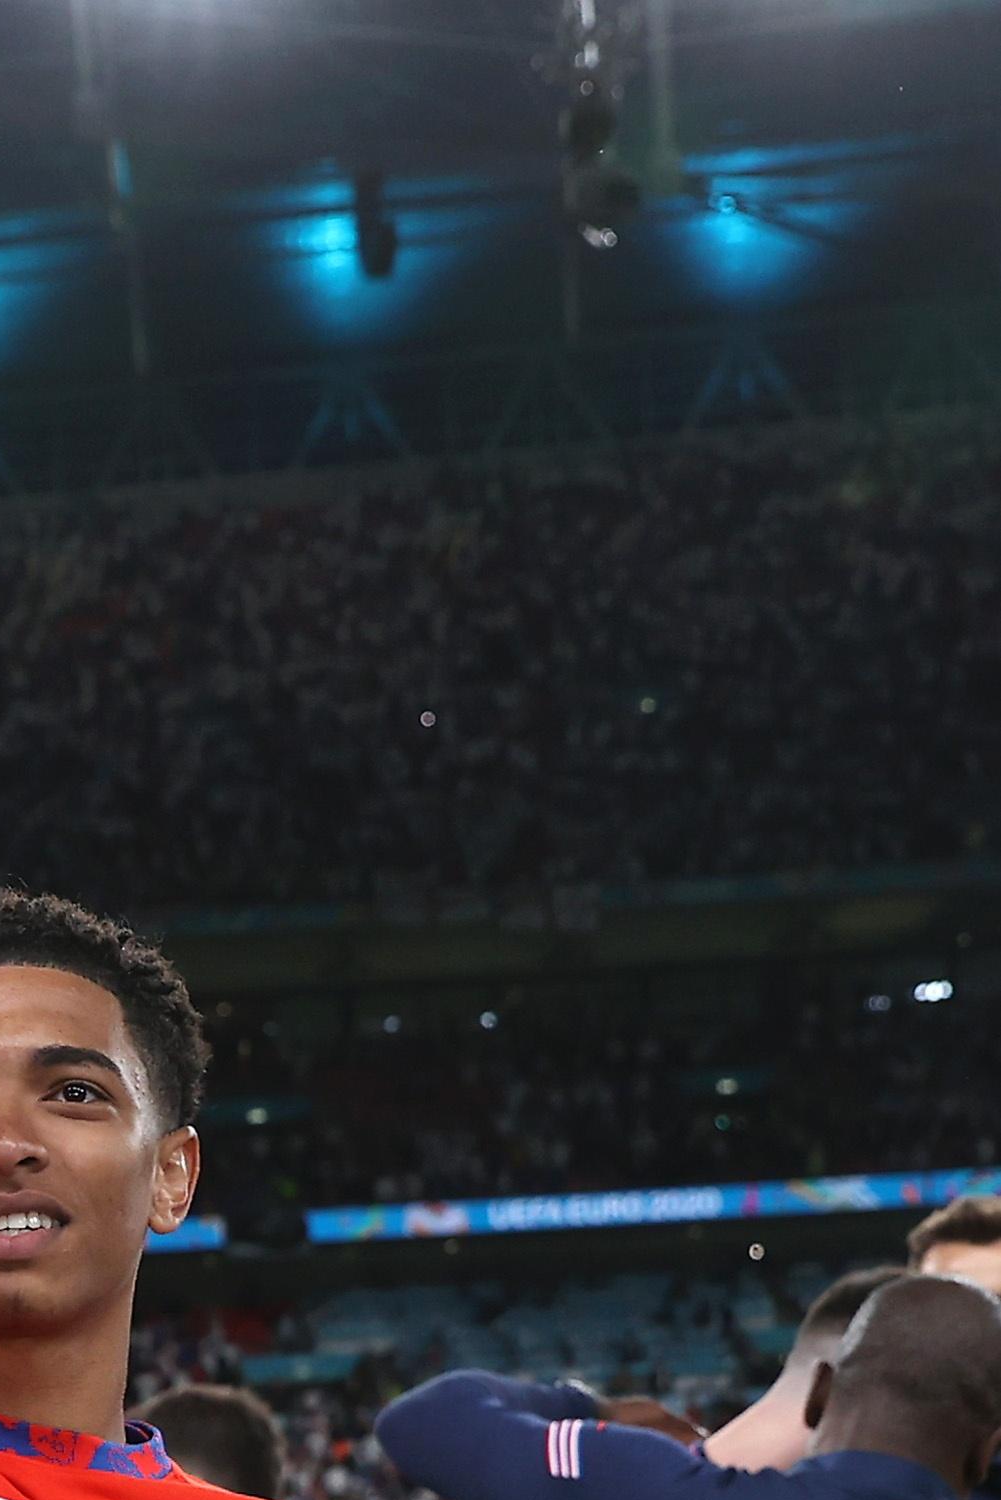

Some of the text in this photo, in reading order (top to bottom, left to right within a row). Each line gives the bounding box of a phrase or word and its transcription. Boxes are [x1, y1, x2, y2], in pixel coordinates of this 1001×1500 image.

[487, 1185, 723, 1232] UEFA EURO 2020
